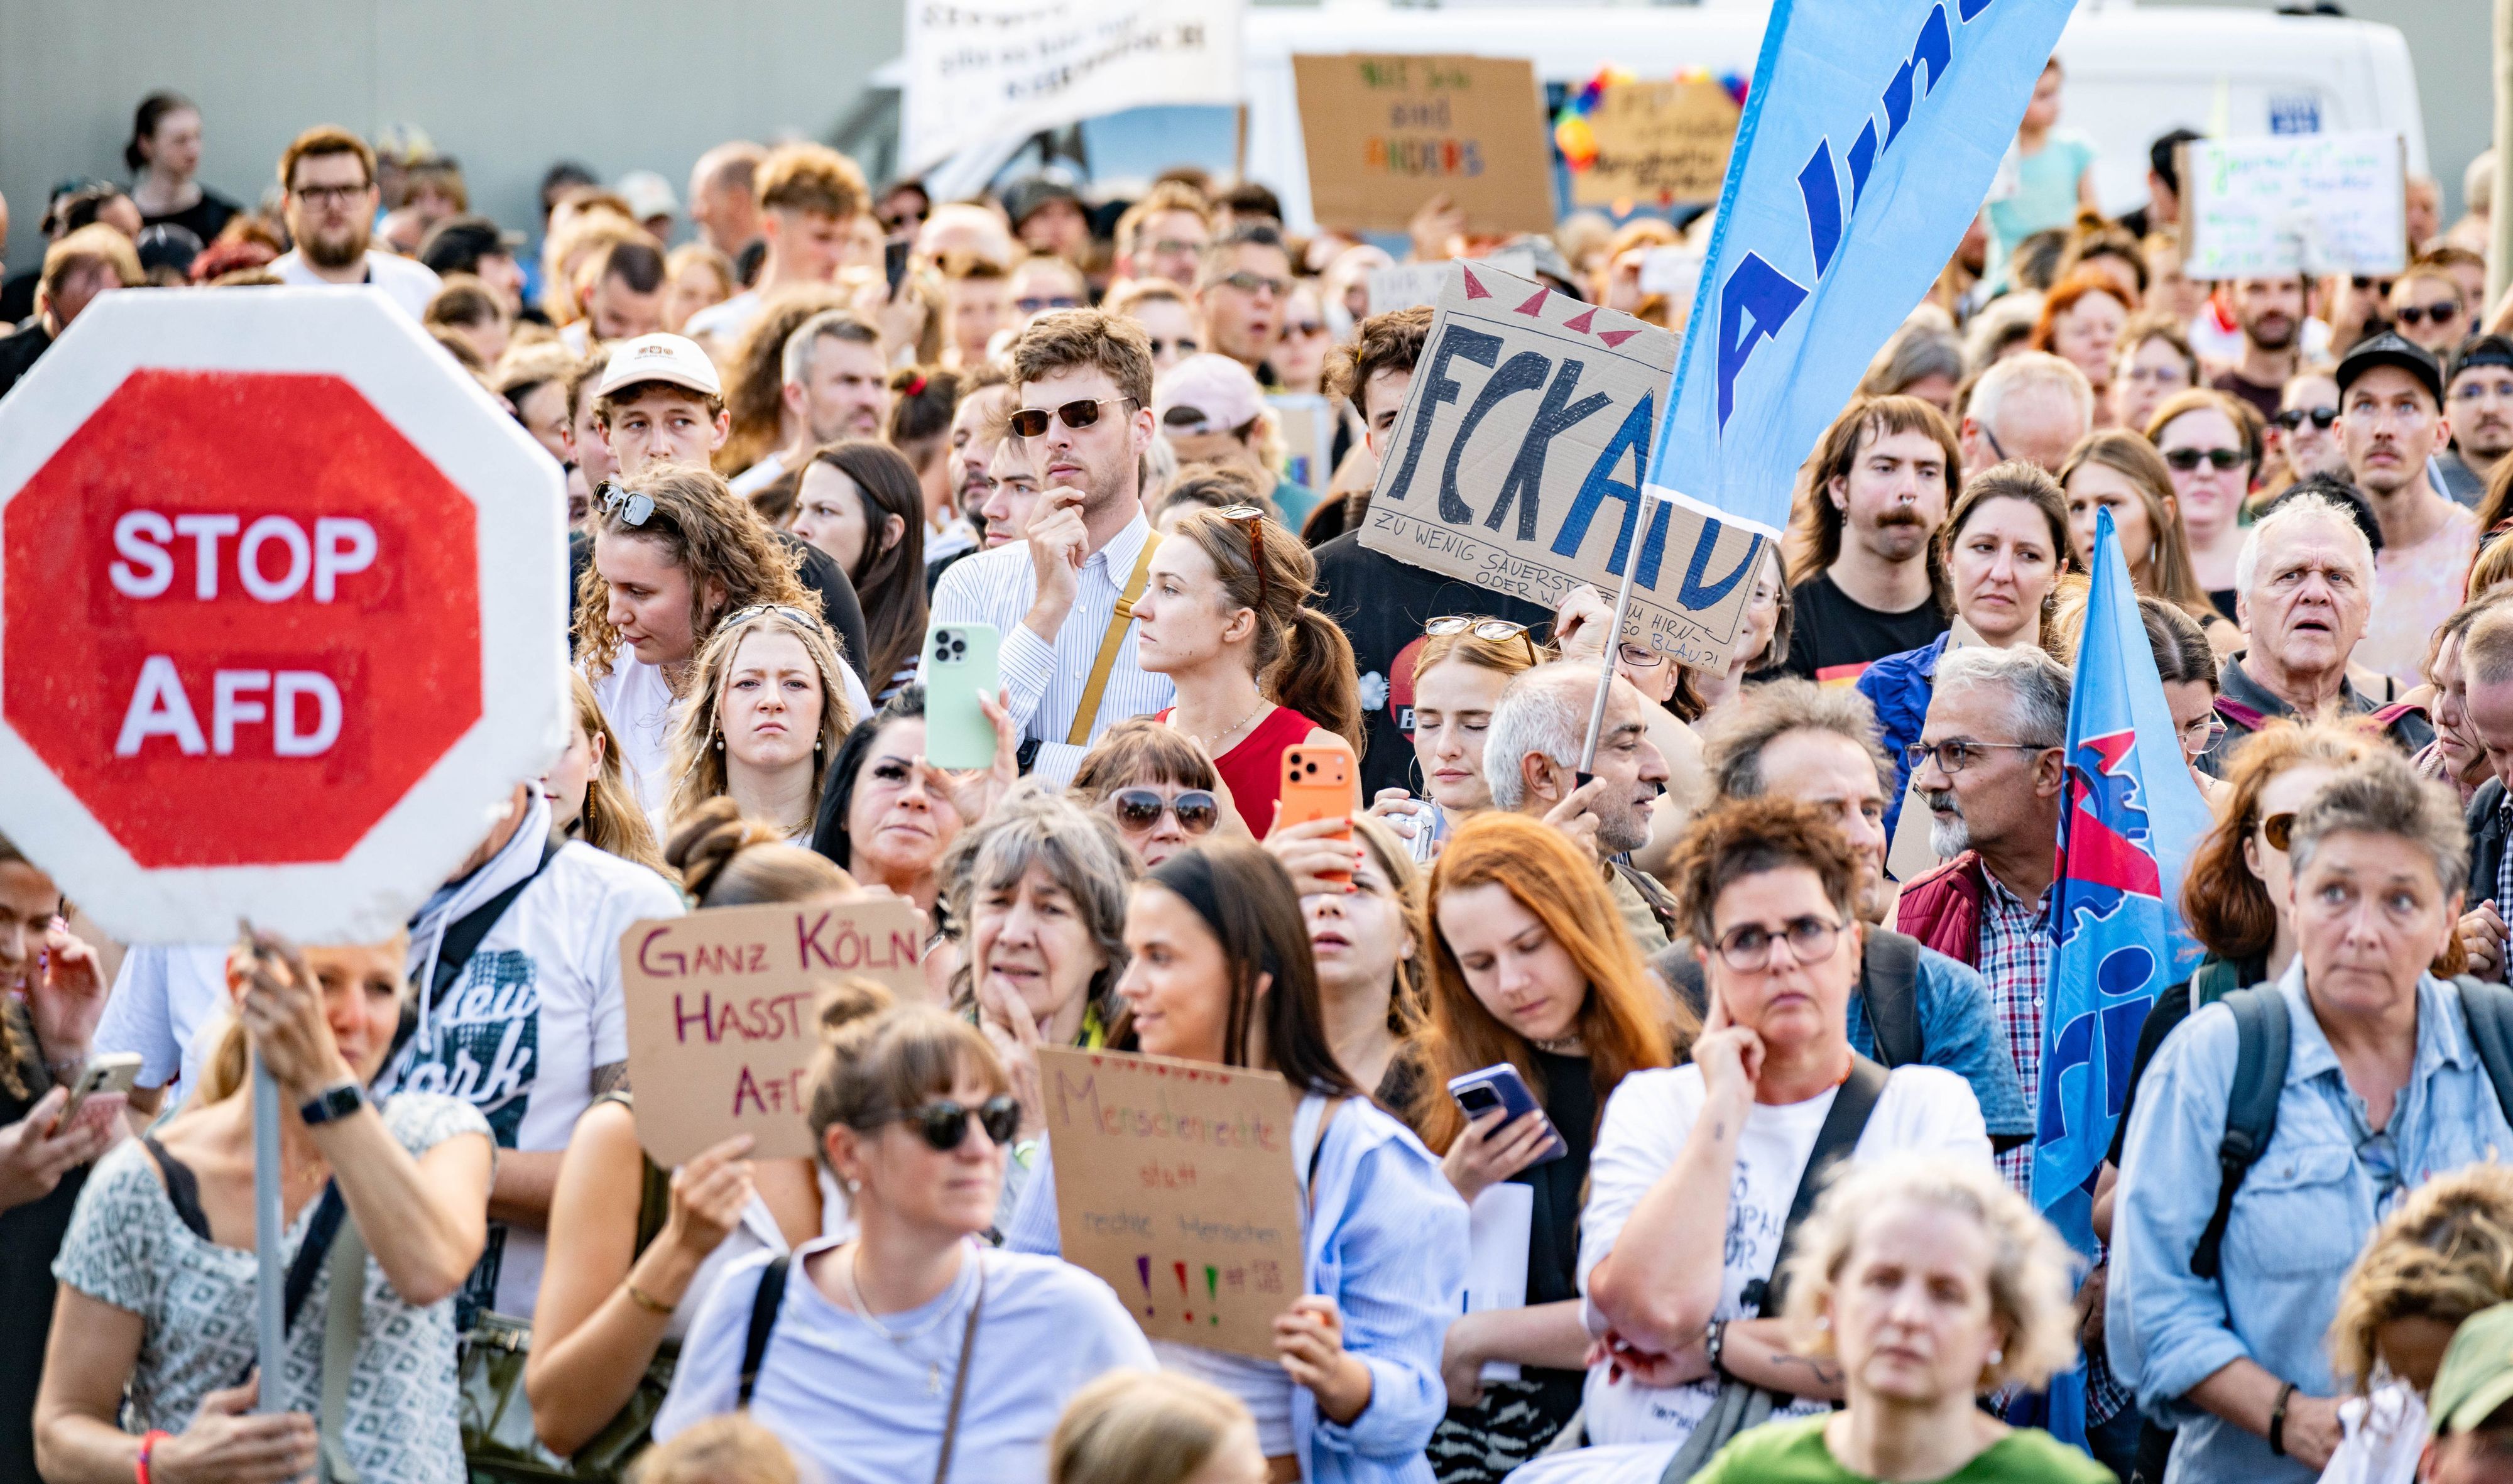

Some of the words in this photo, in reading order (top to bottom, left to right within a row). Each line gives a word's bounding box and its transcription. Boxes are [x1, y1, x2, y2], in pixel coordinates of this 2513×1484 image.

[1386, 323, 1613, 542] FCK
[1549, 387, 1764, 611] AD
[108, 510, 378, 603] STOP
[1374, 513, 1406, 535] ZU
[1415, 525, 1477, 561] WENIG
[1480, 554, 1616, 604] SAUERSTF
[1626, 603, 1644, 621] IM
[1652, 613, 1701, 643] HIRN-
[1476, 572, 1532, 599] ODER
[1651, 633, 1719, 668] BLAU?!
[114, 655, 343, 756] AFD
[797, 910, 919, 970] KÖLN
[404, 1018, 535, 1107] ork
[674, 991, 815, 1044] HASST
[1055, 1068, 1280, 1154] Menschenrechte
[1138, 1160, 1197, 1190] statt
